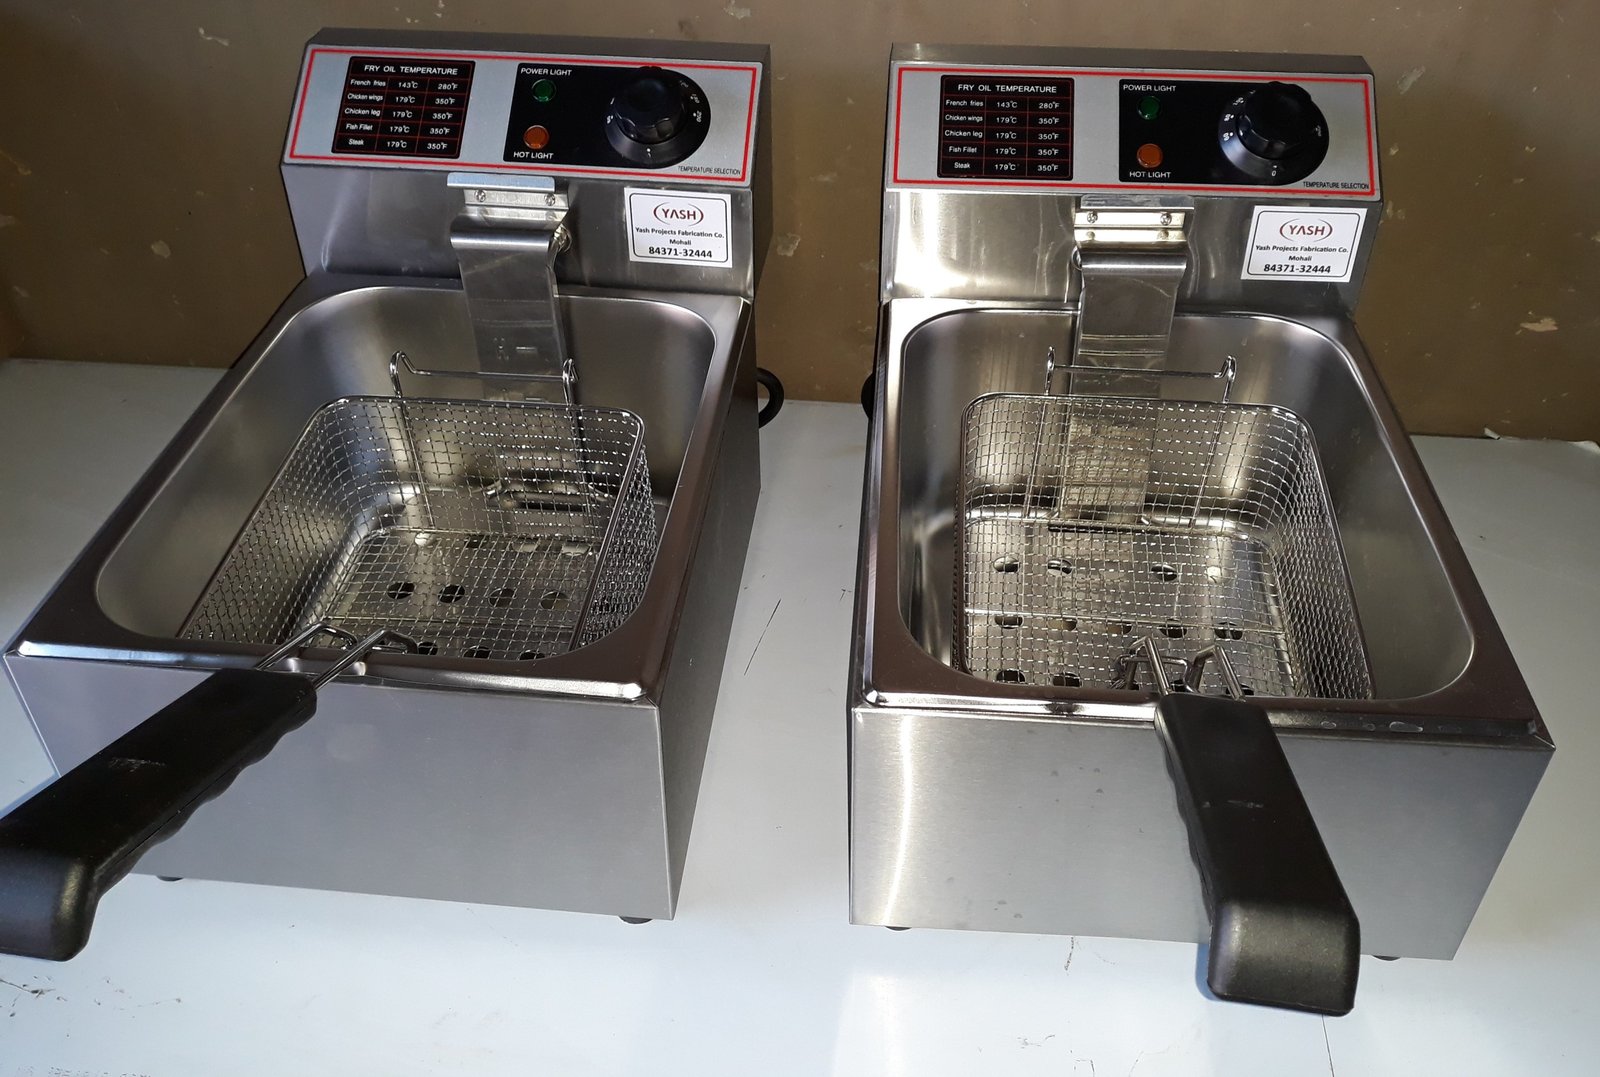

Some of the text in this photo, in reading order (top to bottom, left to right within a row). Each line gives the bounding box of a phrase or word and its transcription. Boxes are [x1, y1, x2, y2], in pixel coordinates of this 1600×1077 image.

[400, 66, 458, 75] TEMPERATURE
[521, 68, 548, 76] POWER
[662, 208, 696, 220] YASH
[1289, 225, 1325, 236] YASH
[648, 246, 712, 258] 84371-32444
[1264, 264, 1331, 273] 84371-32444
